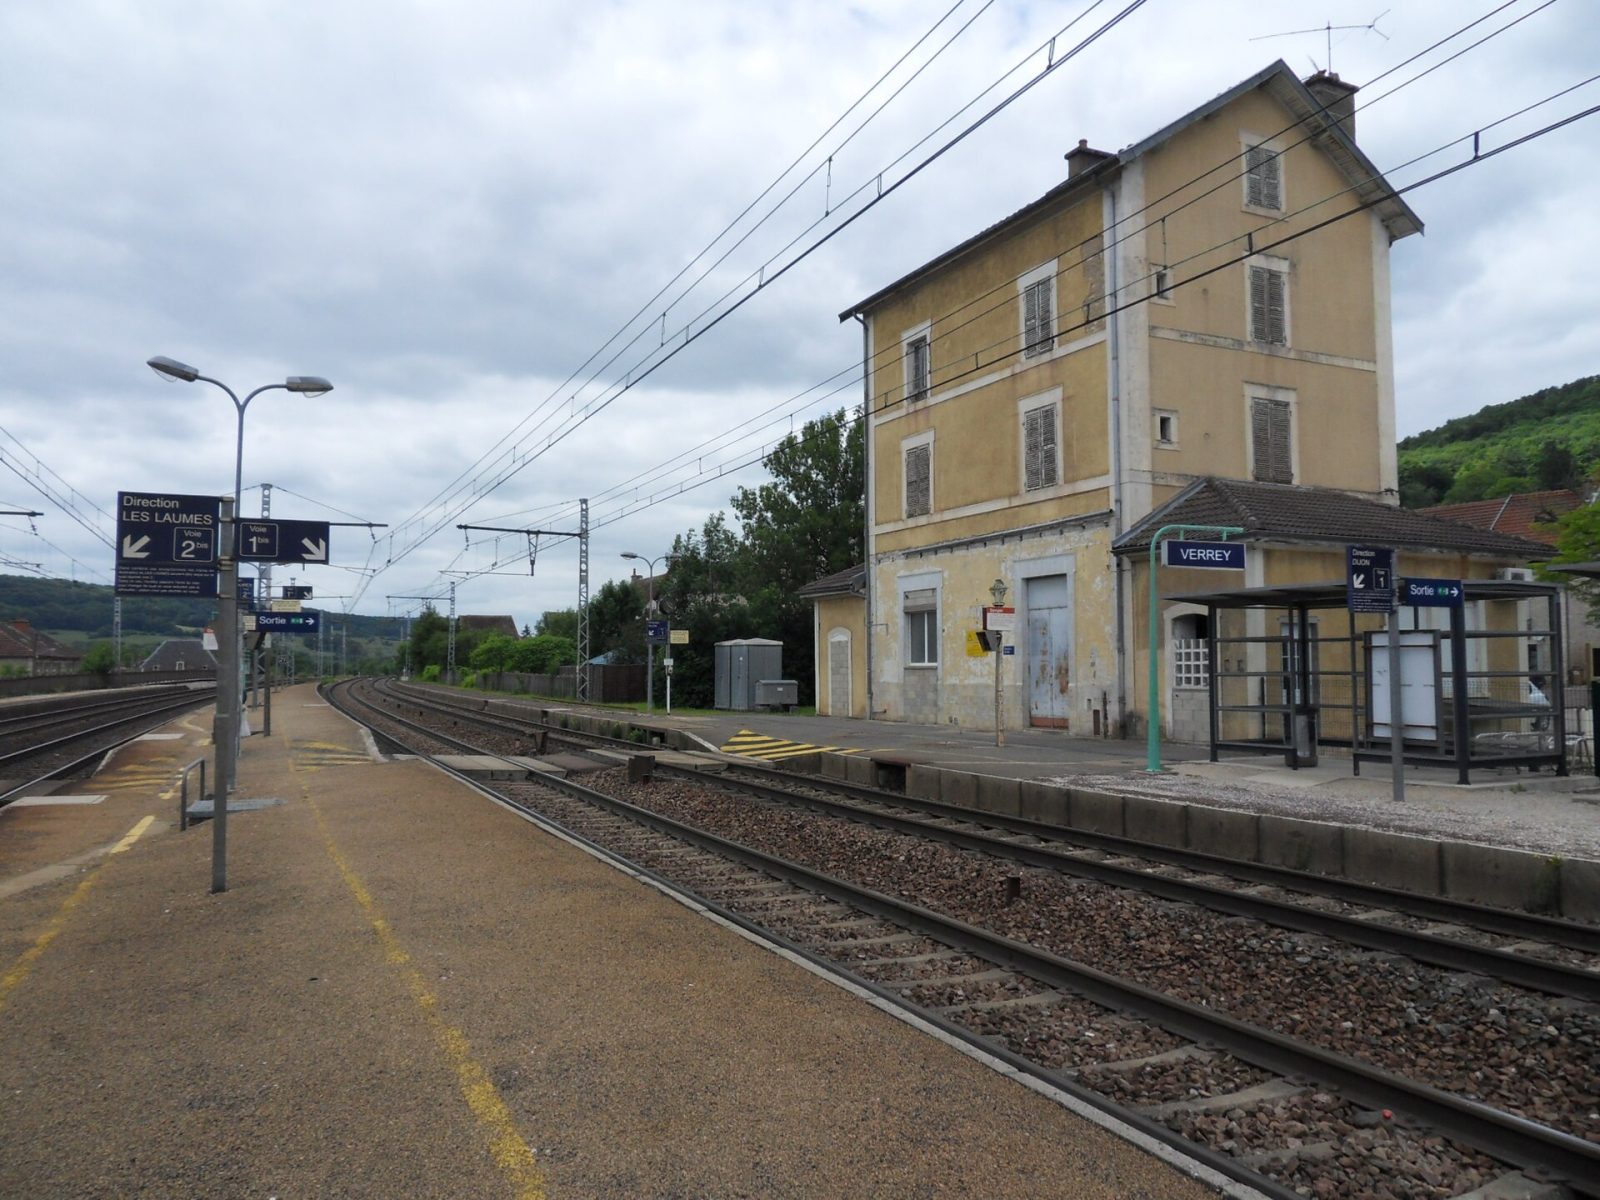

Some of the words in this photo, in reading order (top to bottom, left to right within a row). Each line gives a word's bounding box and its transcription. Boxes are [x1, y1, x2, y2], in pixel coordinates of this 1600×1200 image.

[123, 495, 179, 509] Direction
[122, 511, 150, 522] LES
[154, 512, 213, 525] LAUMES
[181, 540, 196, 558] 2
[248, 536, 257, 553] 1
[1179, 548, 1232, 561] VERREY
[1352, 548, 1376, 557] Direction
[1410, 584, 1435, 596] Sortie
[259, 616, 287, 625] Sortie
